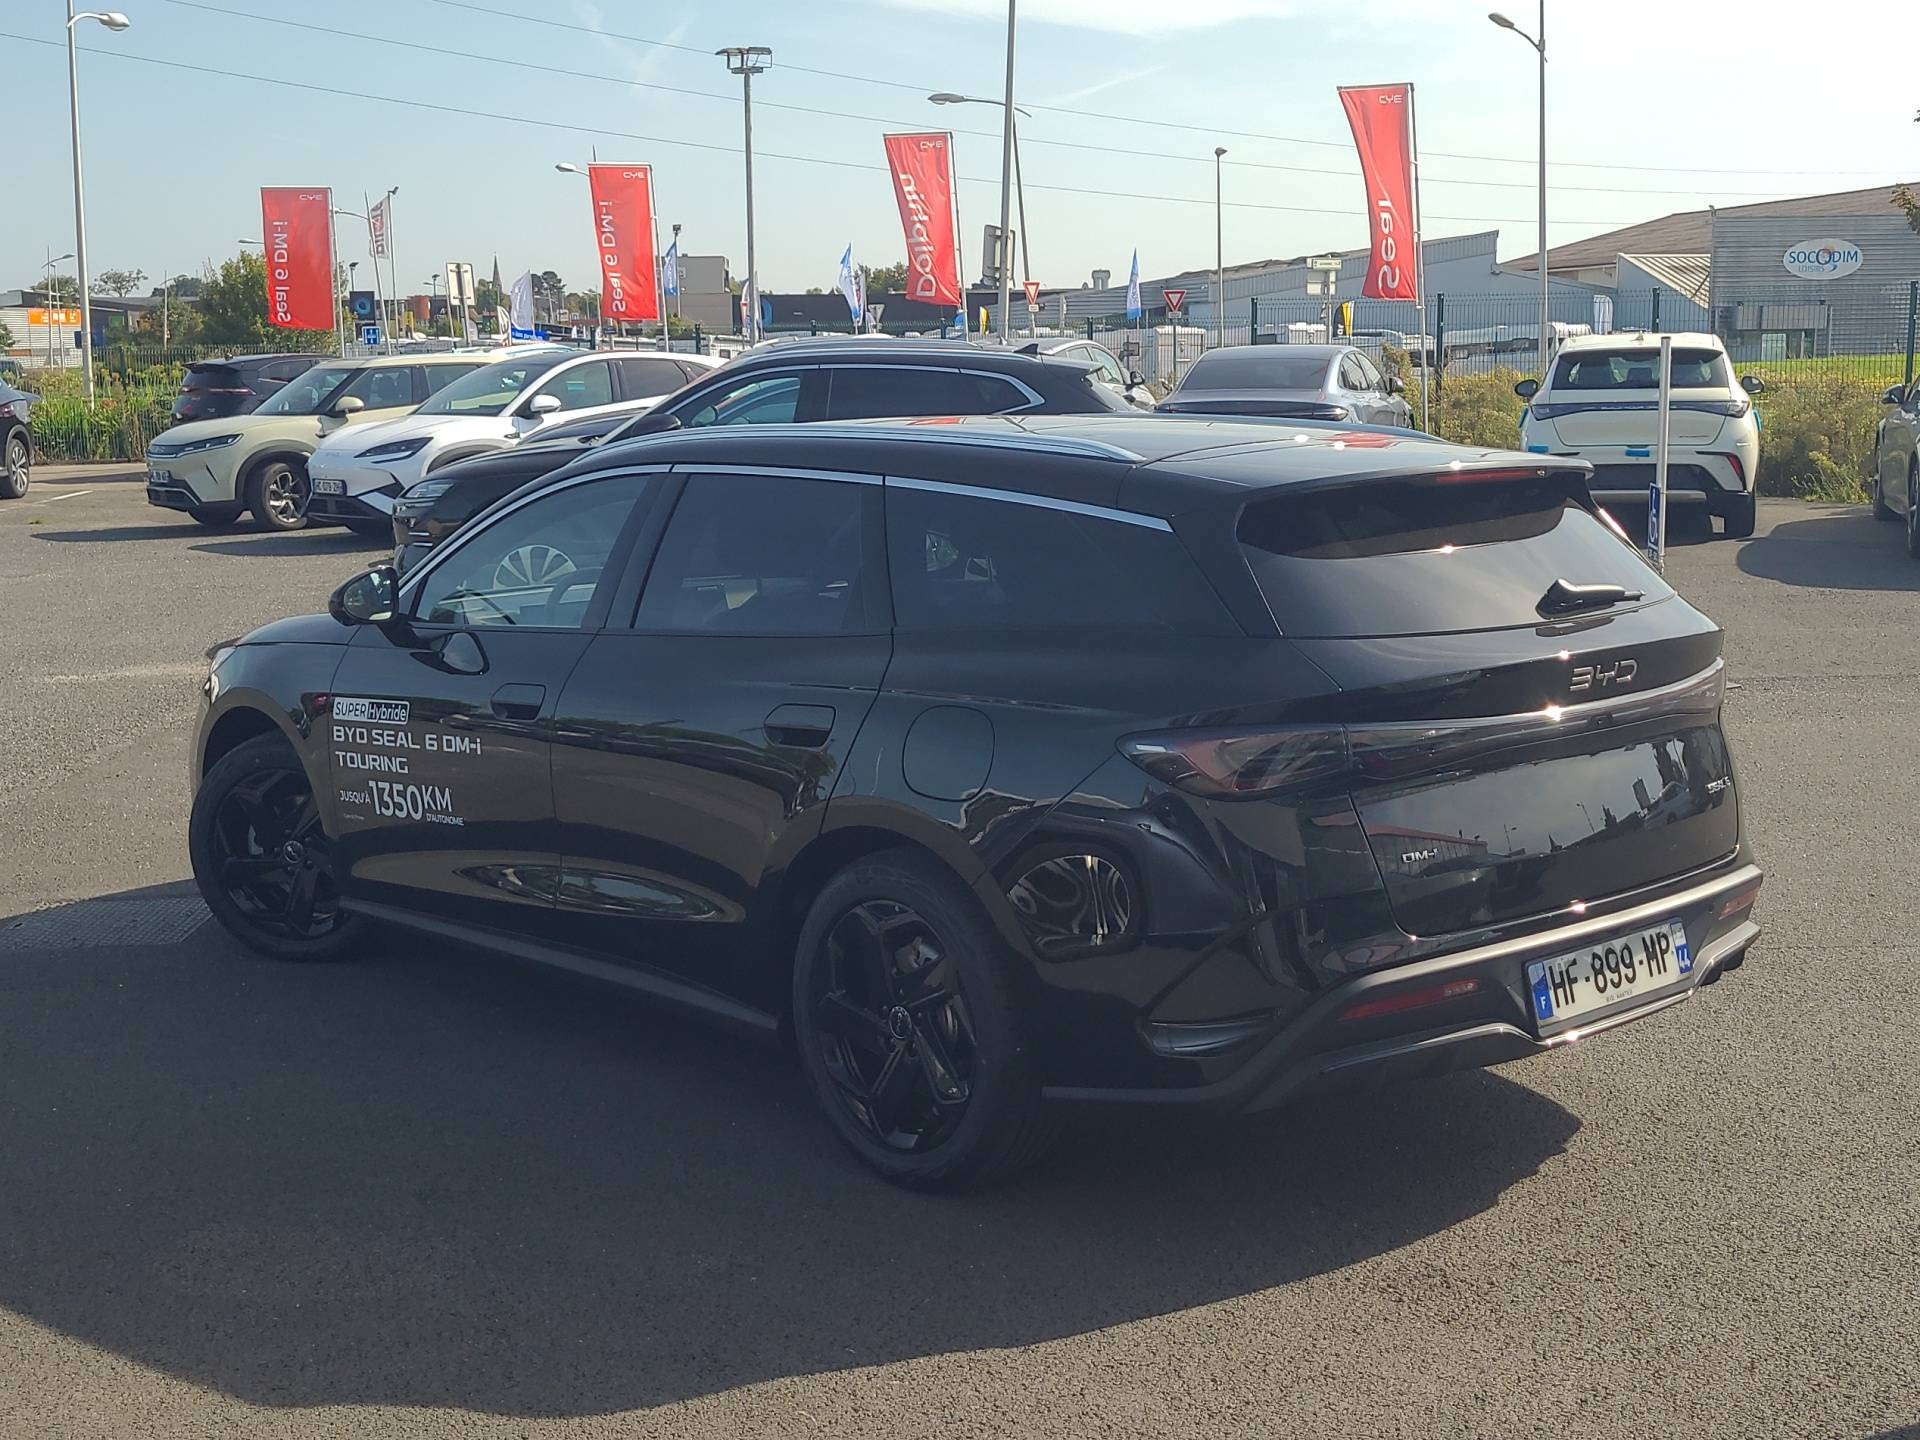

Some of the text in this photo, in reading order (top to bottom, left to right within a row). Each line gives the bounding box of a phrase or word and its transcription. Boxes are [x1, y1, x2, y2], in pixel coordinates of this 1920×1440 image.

[1789, 248, 1858, 265] SOCODIM
[1569, 659, 1639, 692] BYD
[333, 726, 481, 755] BYD SEAL 6 DM-i
[335, 751, 409, 773] TOURING
[1678, 947, 1691, 969] 44
[1540, 996, 1547, 1010] F
